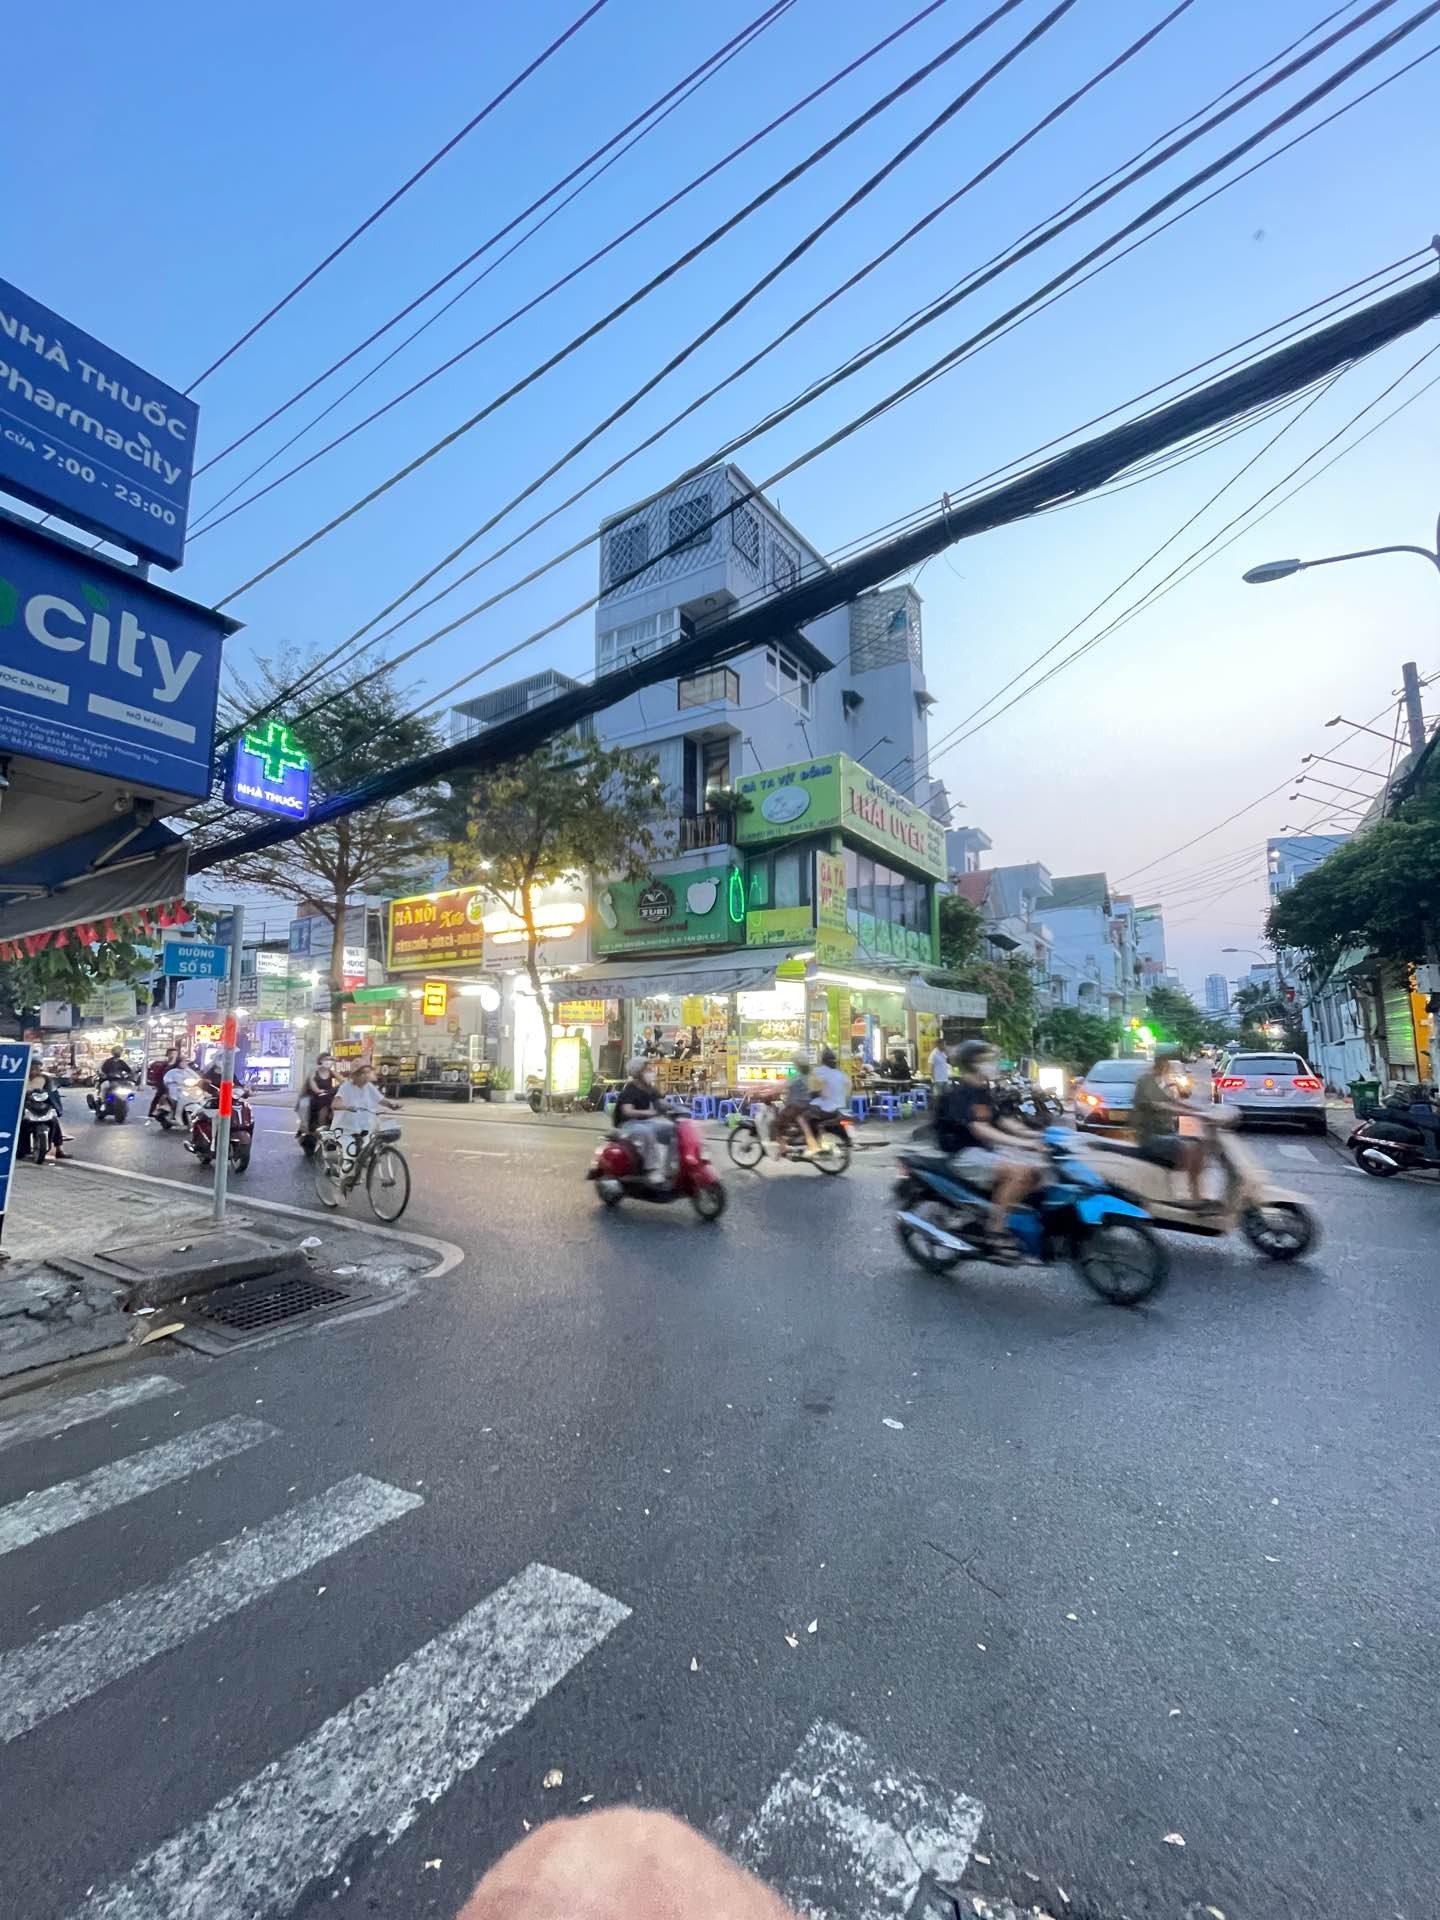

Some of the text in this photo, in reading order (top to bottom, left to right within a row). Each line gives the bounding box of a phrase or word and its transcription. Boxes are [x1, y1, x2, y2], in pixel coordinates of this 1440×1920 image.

[0, 310, 187, 441] NHÀ THUỐC
[42, 444, 96, 483] 7:00
[114, 483, 176, 526] 23:00
[237, 783, 303, 811] NHÀ THUỐC
[178, 947, 215, 958] ĐƯỜNG
[179, 958, 212, 974] SỐ 51
